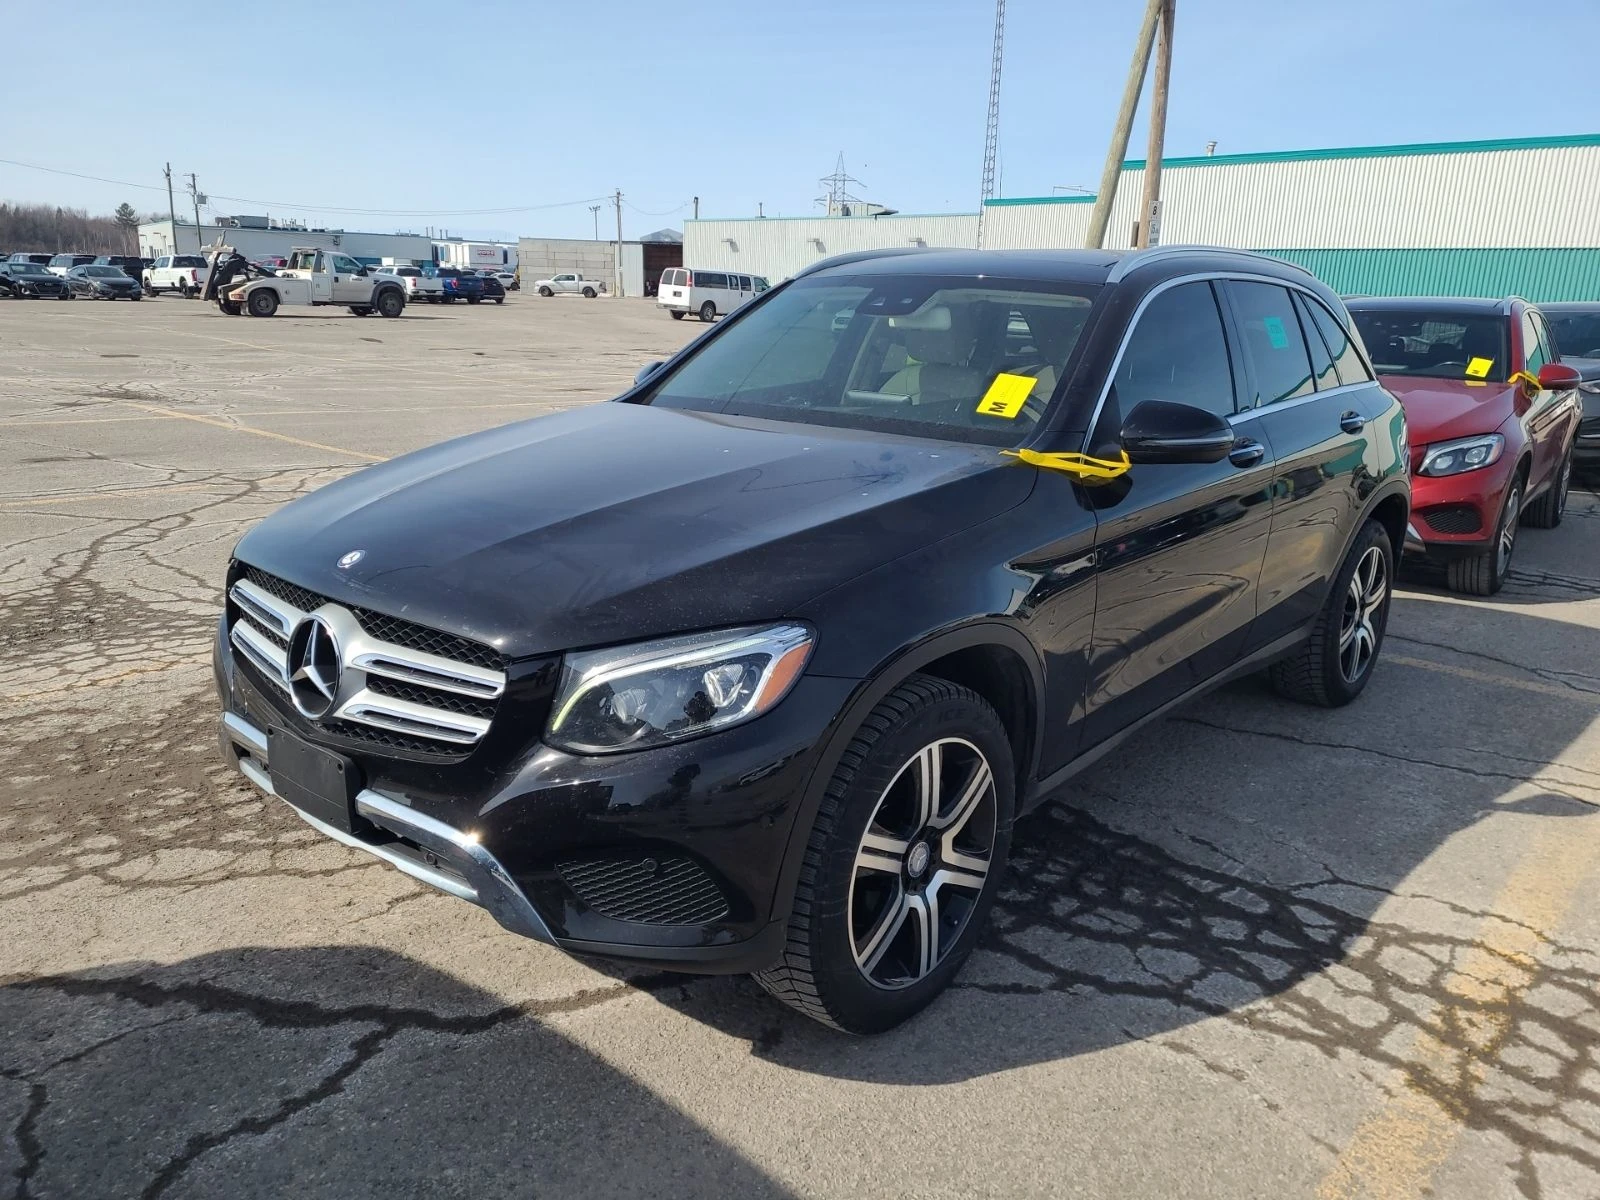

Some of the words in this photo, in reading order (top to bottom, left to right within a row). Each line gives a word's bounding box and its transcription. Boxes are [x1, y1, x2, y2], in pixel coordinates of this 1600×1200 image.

[1152, 205, 1158, 216] 8
[988, 401, 1008, 413] M
[938, 708, 967, 724] ICE
